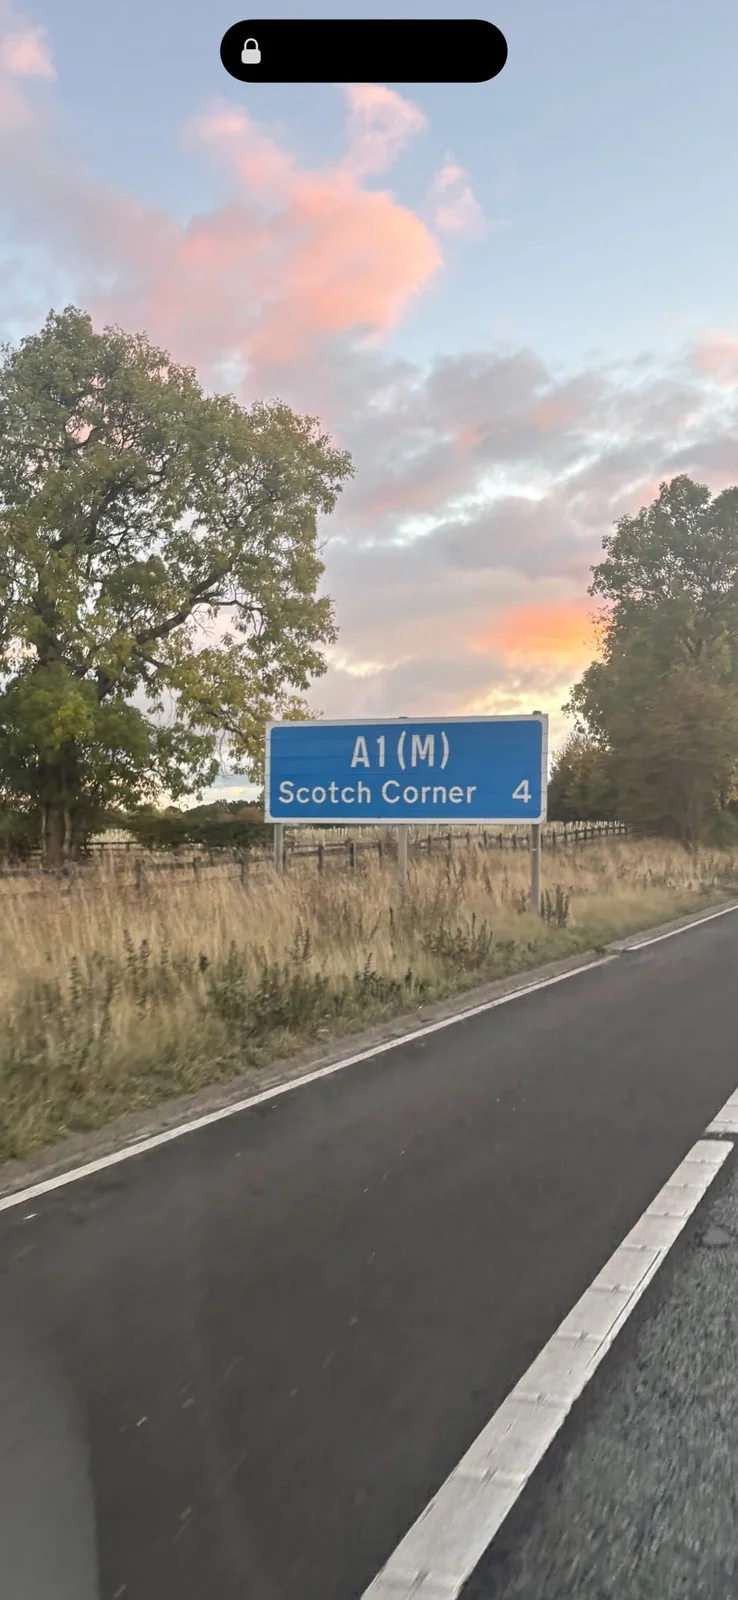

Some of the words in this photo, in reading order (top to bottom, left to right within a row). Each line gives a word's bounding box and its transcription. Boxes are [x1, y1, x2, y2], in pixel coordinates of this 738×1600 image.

[350, 730, 450, 770] A1(M)
[278, 780, 372, 804] Scotch
[381, 780, 477, 804] Corner
[511, 779, 532, 804] 4
